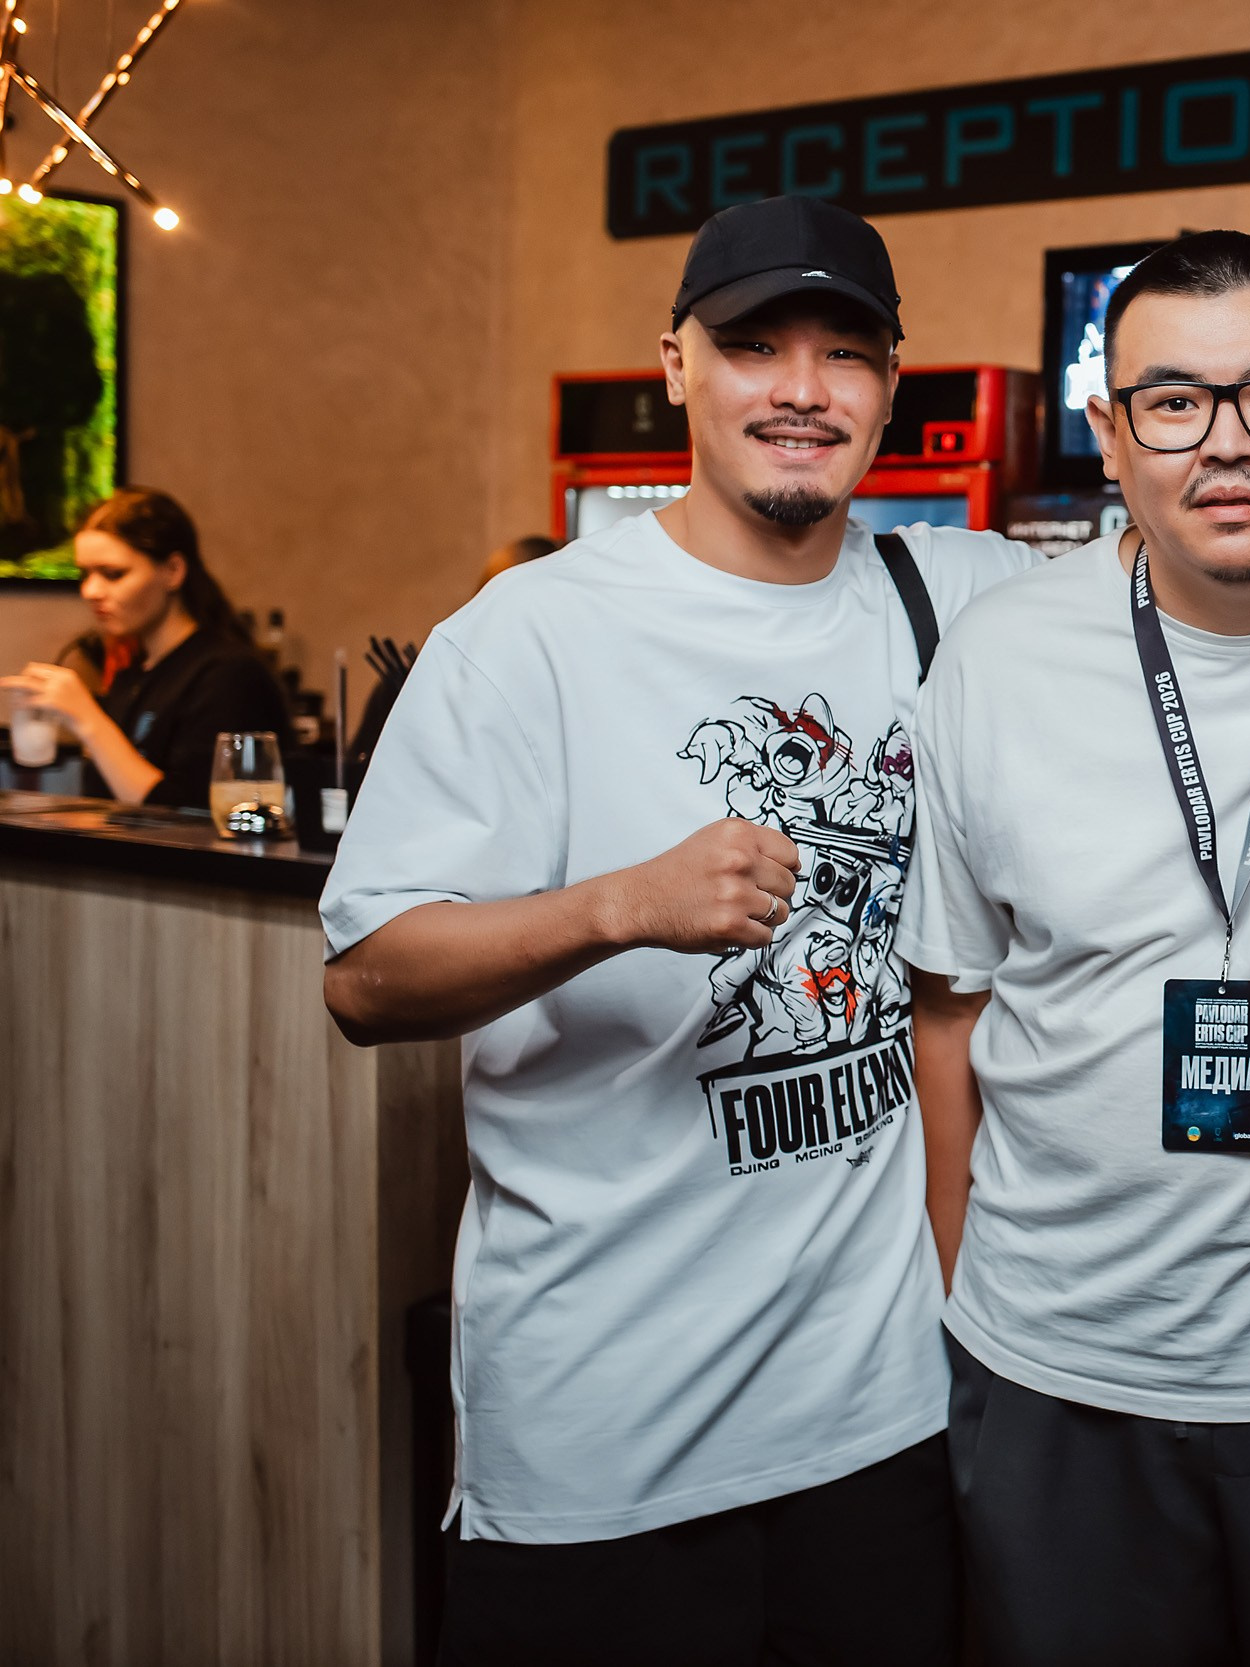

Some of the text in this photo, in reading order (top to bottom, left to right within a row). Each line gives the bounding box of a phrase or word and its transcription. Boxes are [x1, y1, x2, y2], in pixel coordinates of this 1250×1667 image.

[1136, 542, 1150, 609] PAVLODA
[1154, 671, 1212, 861] PAVLODAR ERTIS CUP 2026
[1195, 1004, 1249, 1024] PAVLODAR
[1195, 1024, 1249, 1044] ERTIS CUP
[719, 1072, 830, 1164] FOUR
[730, 1158, 780, 1177] DJING
[795, 1143, 843, 1164] MCING
